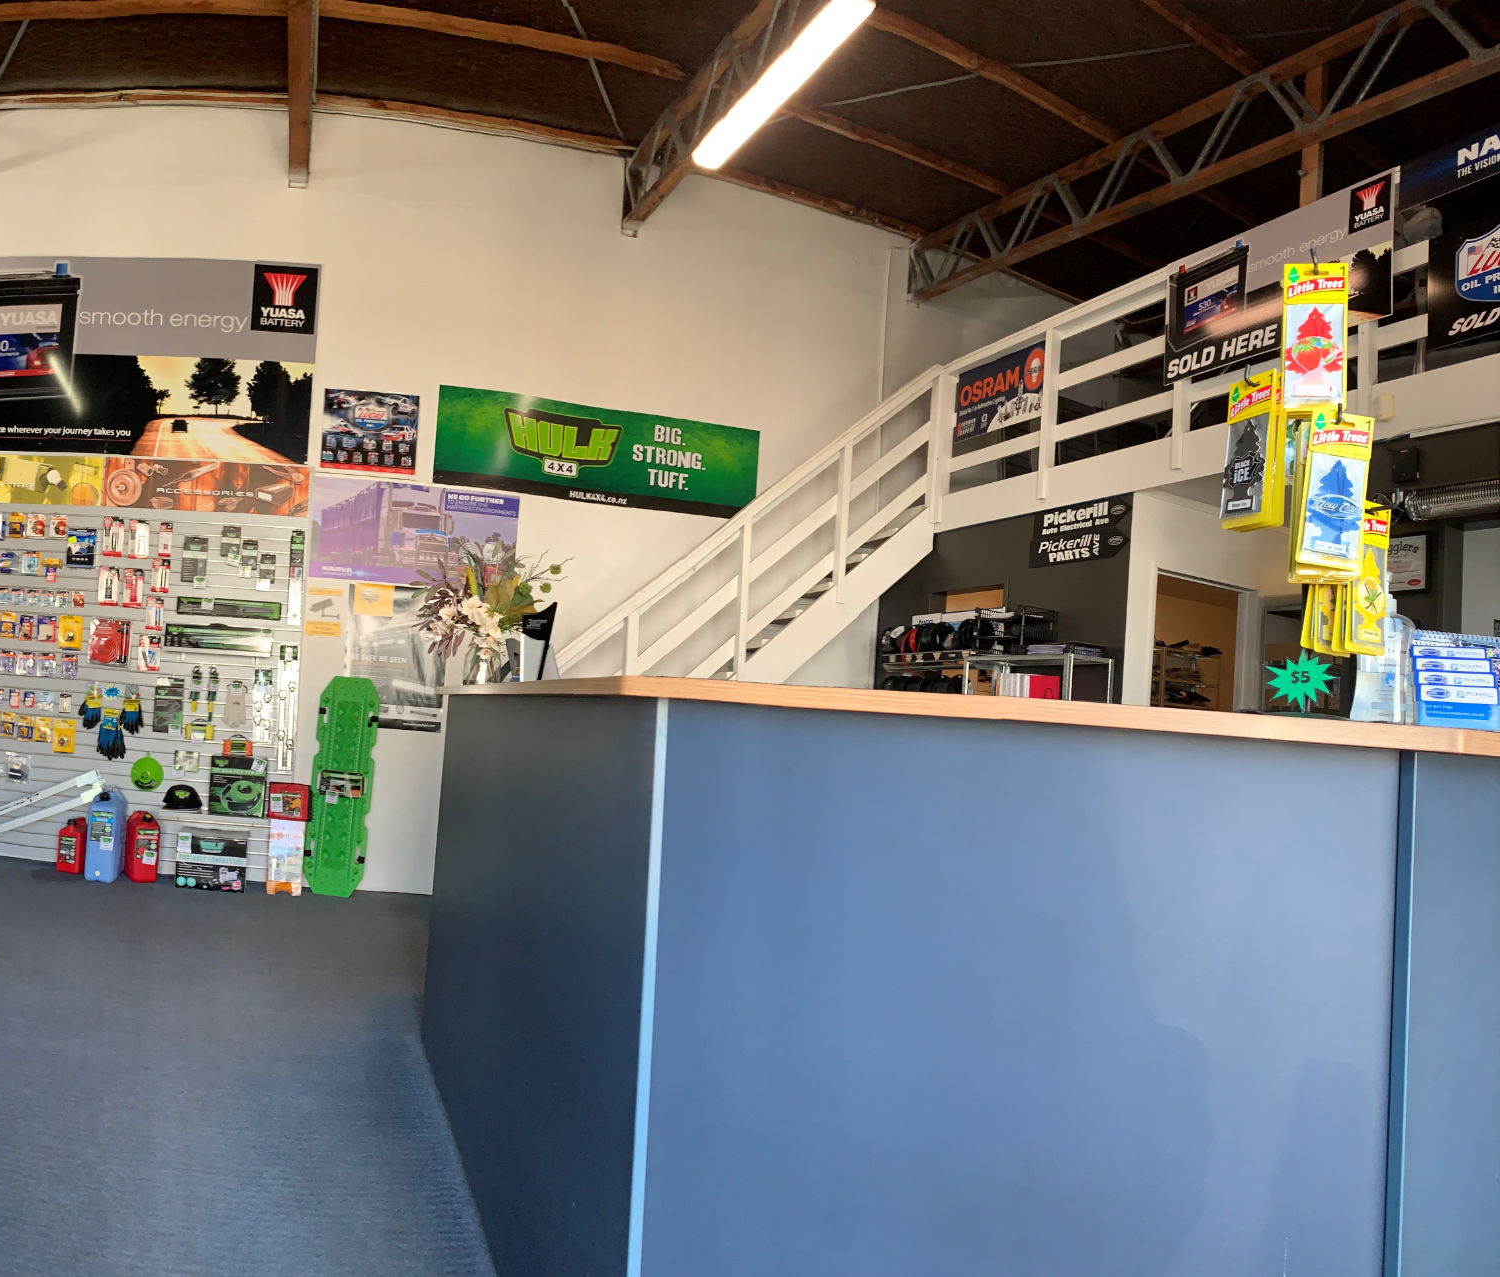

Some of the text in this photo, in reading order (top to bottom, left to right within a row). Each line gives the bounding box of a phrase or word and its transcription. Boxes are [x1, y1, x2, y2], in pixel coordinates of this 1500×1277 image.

[1457, 165, 1473, 179] THE
[1354, 205, 1385, 223] YUASA
[1354, 213, 1385, 229] BATTERY
[1248, 226, 1348, 273] smooth energy
[1206, 271, 1238, 291] YUASA
[1287, 278, 1345, 298] Little Trees
[1461, 279, 1482, 292] OIL
[0, 310, 58, 327] YUASA
[79, 309, 249, 333] smooth energy
[260, 306, 305, 320] YUASA
[1448, 306, 1500, 336] SOLD
[260, 317, 305, 328] BATTERY
[1166, 323, 1279, 379] SOLD HERE
[960, 366, 1020, 407] OSRAM
[1230, 395, 1250, 419] Little
[1251, 387, 1271, 402] Trees
[358, 411, 386, 419] LUCAS
[7, 425, 43, 434] wherever
[43, 427, 62, 435] your
[62, 427, 93, 436] journey
[93, 427, 115, 436] takes
[115, 429, 131, 437] you
[507, 411, 620, 461] HULK
[654, 424, 687, 447] BIG.
[1312, 430, 1370, 446] Little Trees
[632, 444, 707, 471] STRONG.
[1234, 459, 1251, 470] BLACK
[547, 462, 574, 475] 4X4
[647, 468, 690, 491] TUFF.
[156, 486, 255, 498] ACCESSORIES
[470, 496, 505, 505] FURTHER
[1313, 499, 1338, 511] New
[1043, 501, 1109, 528] Pickerill
[1041, 517, 1110, 536] Auto Electrical Ave
[1370, 520, 1388, 533] Trees
[1038, 533, 1093, 554] Pickerill
[1092, 533, 1101, 556] AVE
[1048, 547, 1091, 563] PARTS
[321, 565, 353, 573] NARVA
[360, 654, 377, 662] SAFE
[389, 656, 408, 664] SEEN
[1290, 670, 1311, 685] $5
